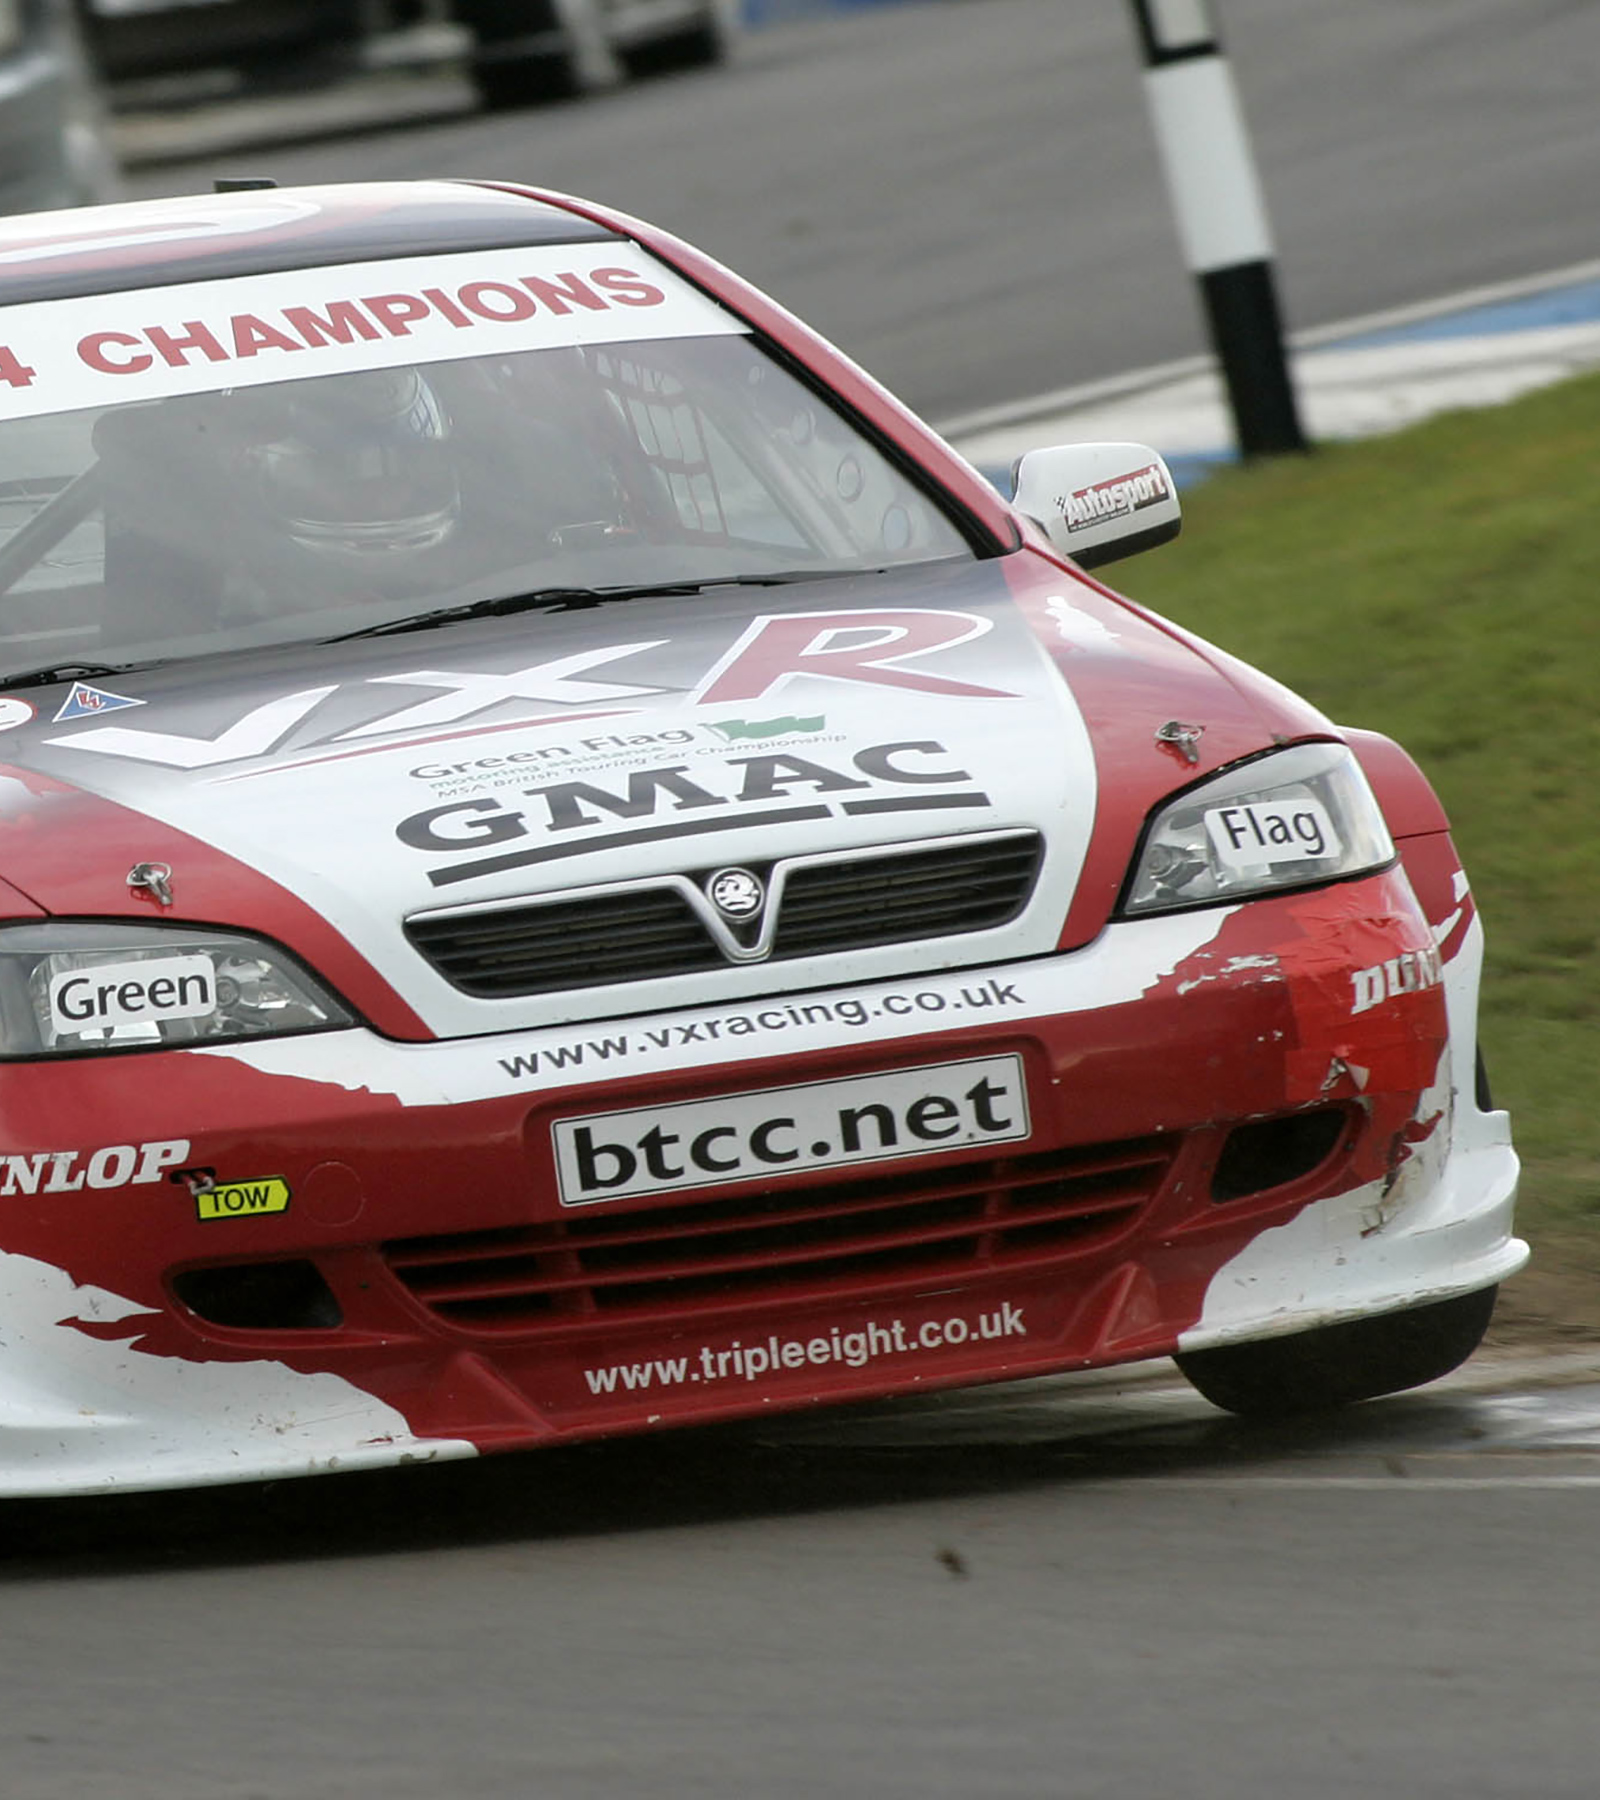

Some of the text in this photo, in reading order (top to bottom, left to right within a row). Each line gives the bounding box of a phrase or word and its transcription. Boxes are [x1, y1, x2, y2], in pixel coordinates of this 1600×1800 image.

[76, 267, 665, 375] CHAMPIONS
[1063, 466, 1167, 525] Autosport
[41, 606, 1028, 771] VXR
[396, 739, 974, 853] GMAC
[409, 728, 695, 779] Green Flag
[1218, 808, 1325, 856] Flag
[56, 972, 210, 1021] Green
[497, 978, 1027, 1079] www.vxracing.co.uk
[572, 1075, 1014, 1193] btcc.net
[211, 1186, 270, 1213] TOW
[584, 1302, 1027, 1394] www.tripleeight.co.uk
